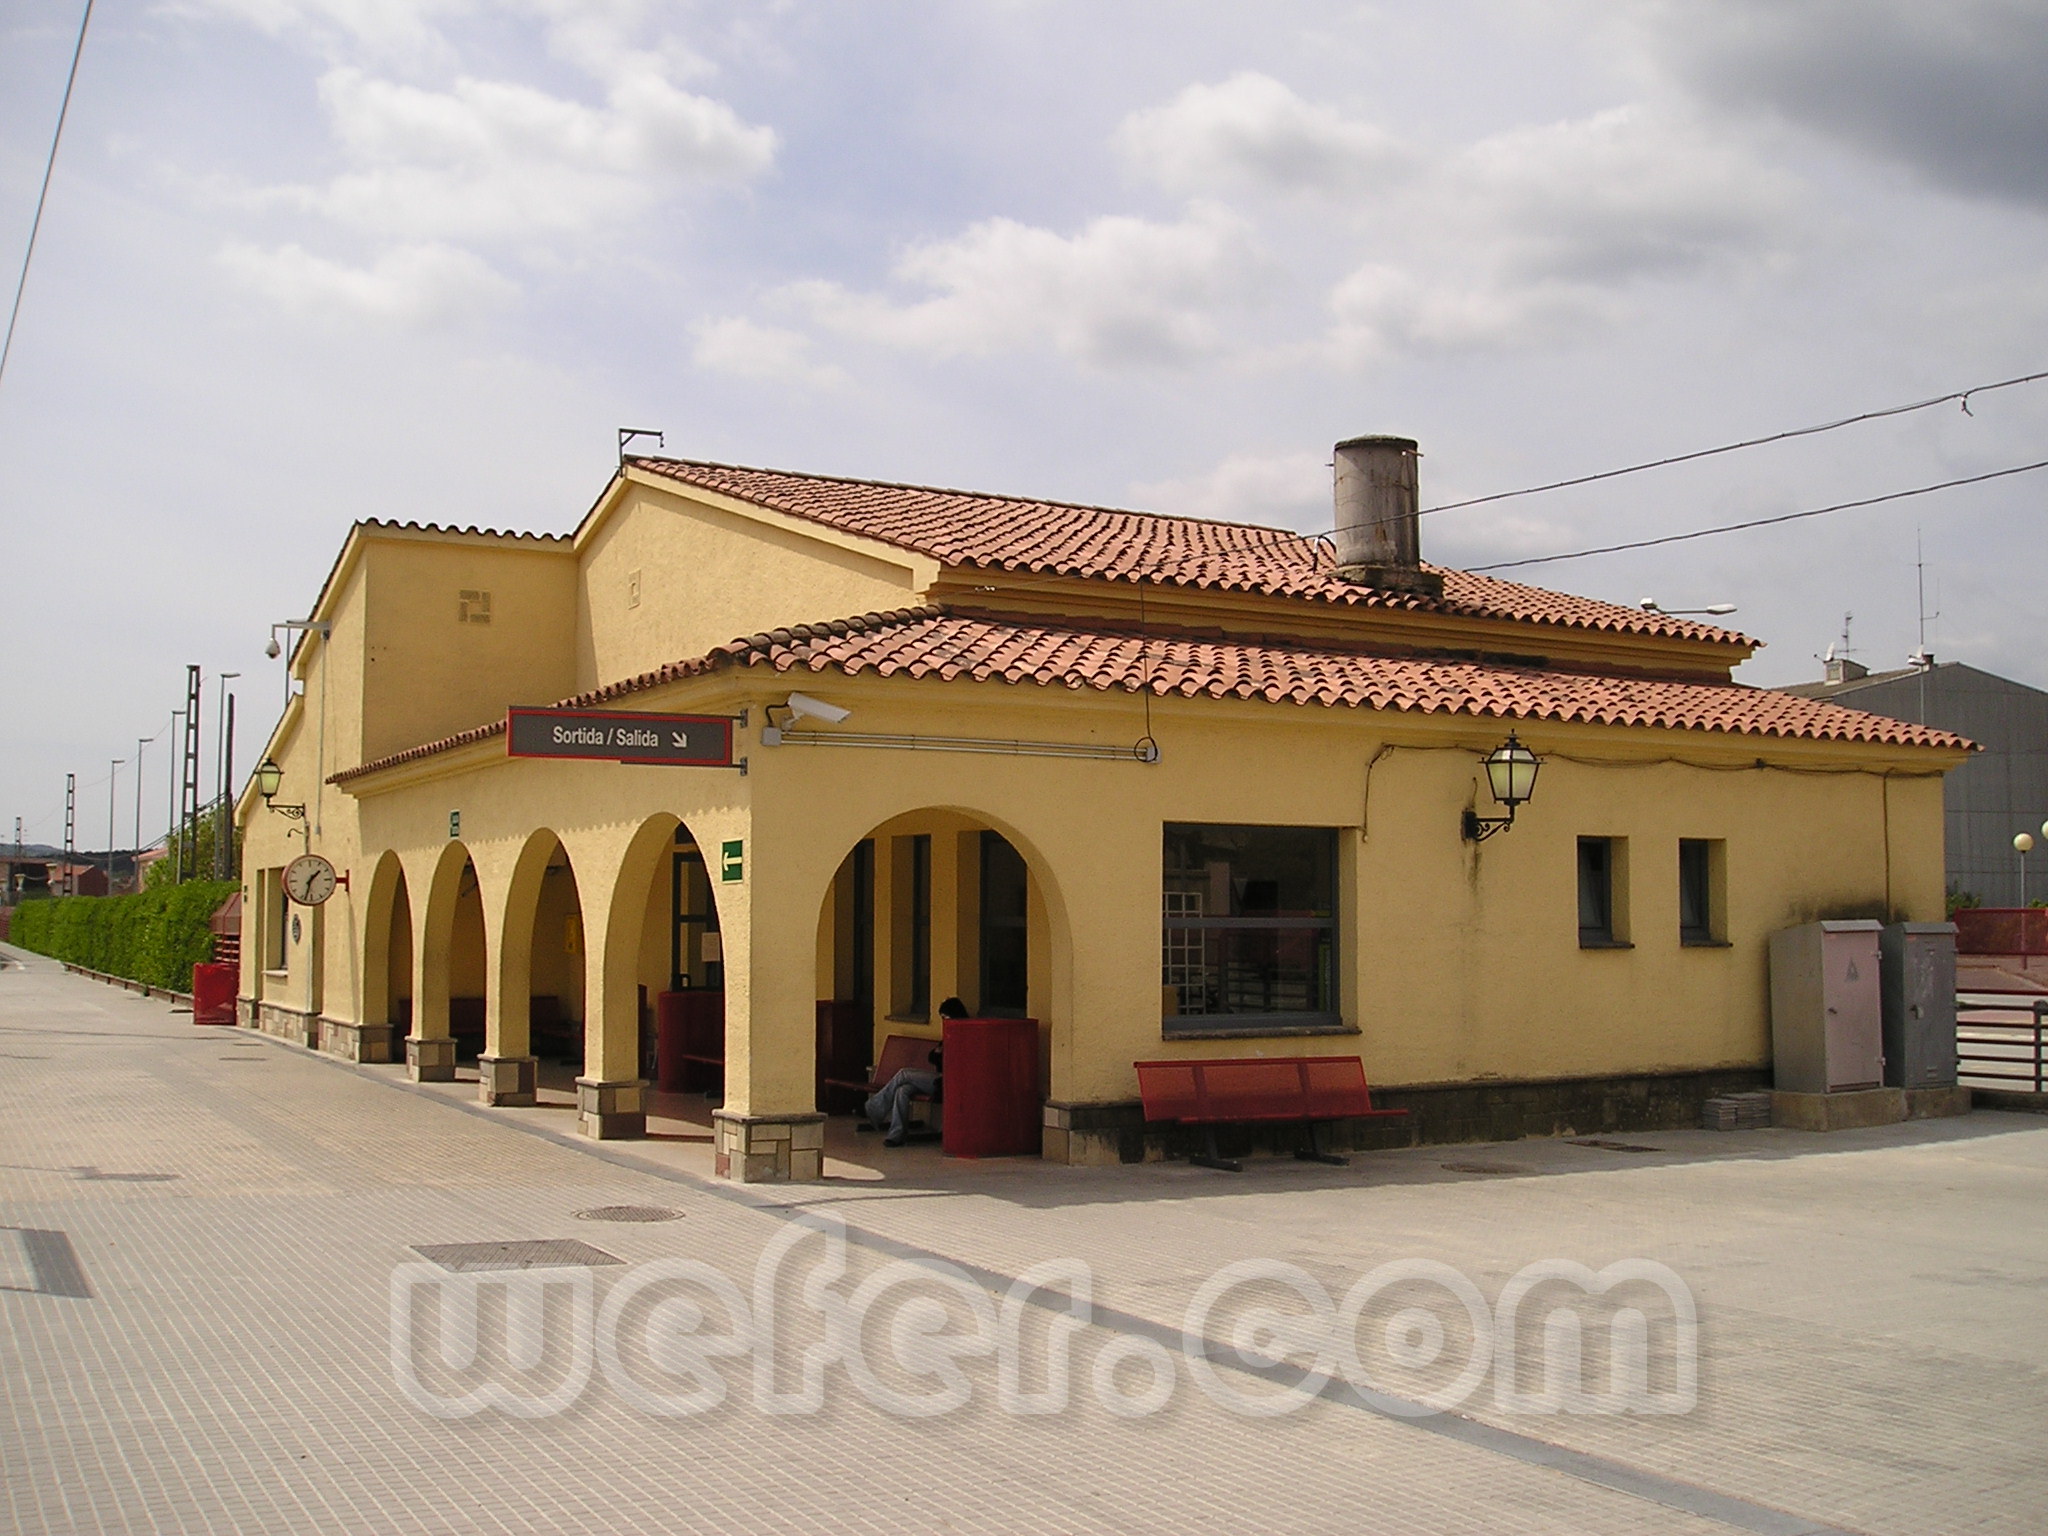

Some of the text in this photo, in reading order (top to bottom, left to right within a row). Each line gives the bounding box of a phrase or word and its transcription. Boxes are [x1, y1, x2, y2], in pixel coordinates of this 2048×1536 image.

[553, 726, 659, 747] Sortida / Salida
